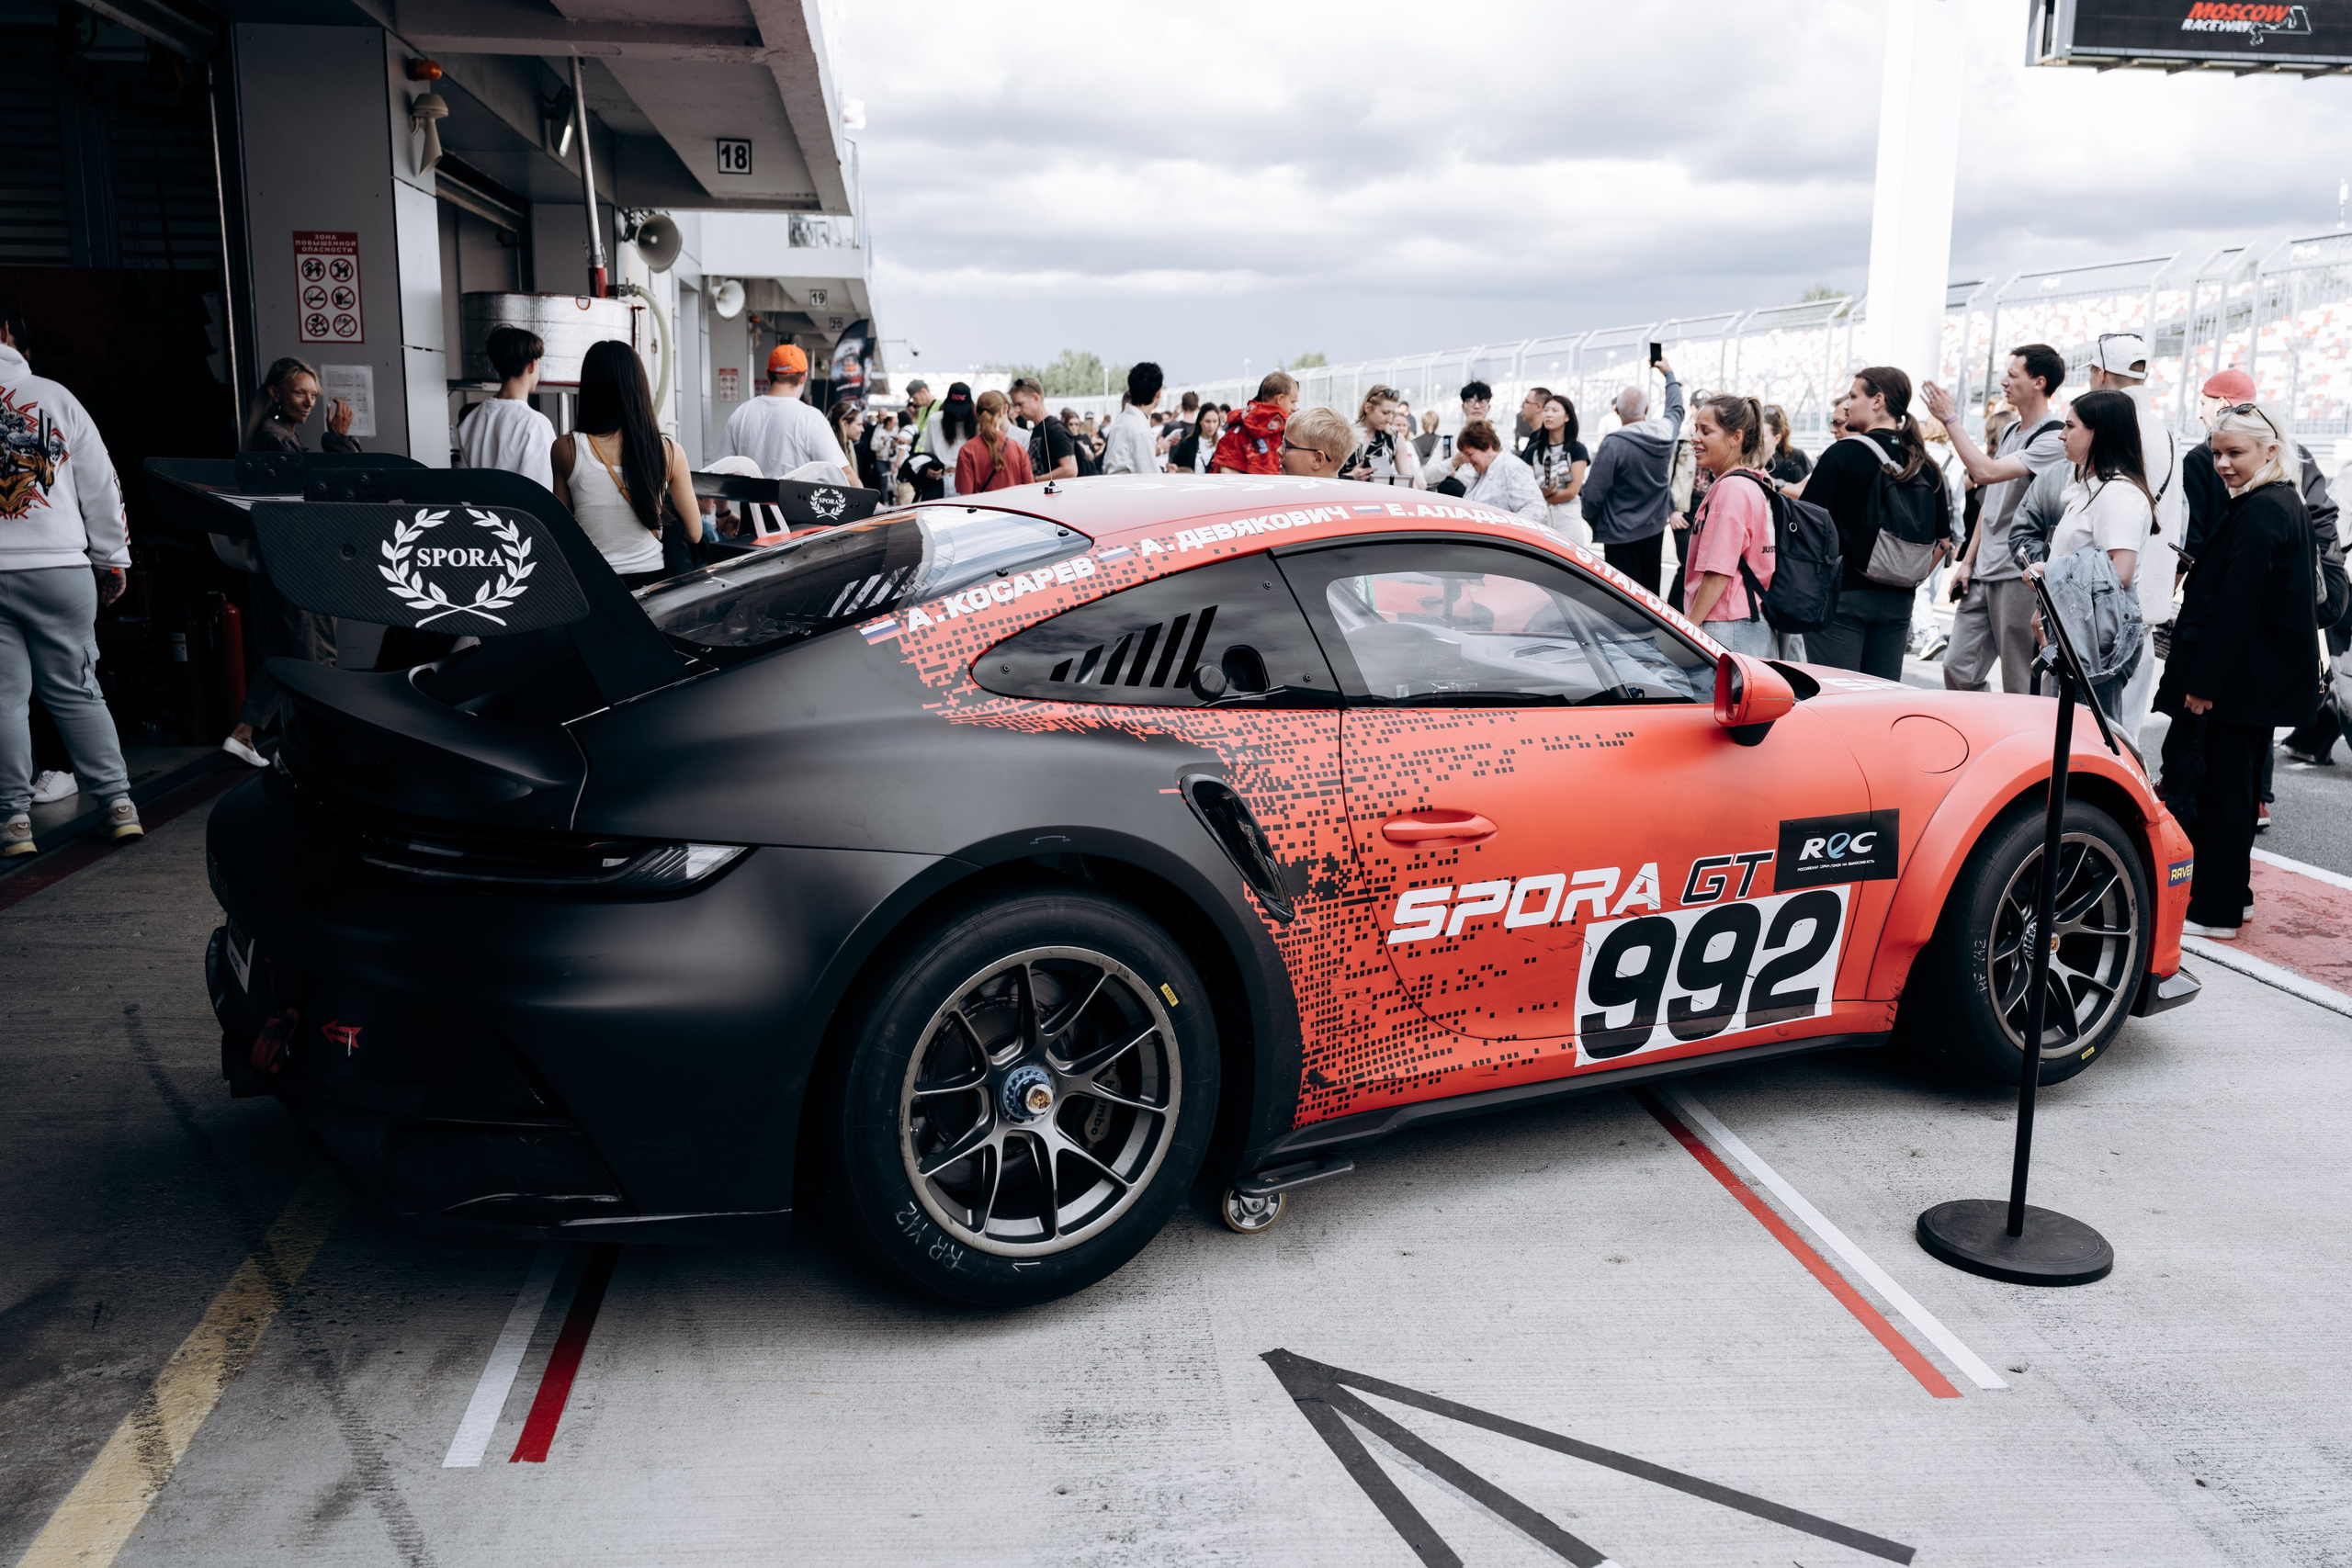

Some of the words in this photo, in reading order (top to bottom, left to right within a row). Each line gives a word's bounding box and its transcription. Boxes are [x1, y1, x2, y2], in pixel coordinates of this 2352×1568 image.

[2187, 2, 2290, 22] MOSCOW
[2181, 18, 2252, 33] RACEWAY
[721, 144, 747, 169] 18
[812, 291, 825, 305] 19
[831, 319, 842, 330] 20
[818, 497, 839, 505] SPORA
[416, 547, 505, 568] SPORA
[1386, 862, 1661, 945] SPORA
[1680, 849, 1776, 906] GT
[1580, 889, 1842, 1059] 992
[1091, 1079, 1115, 1136] bmbo
